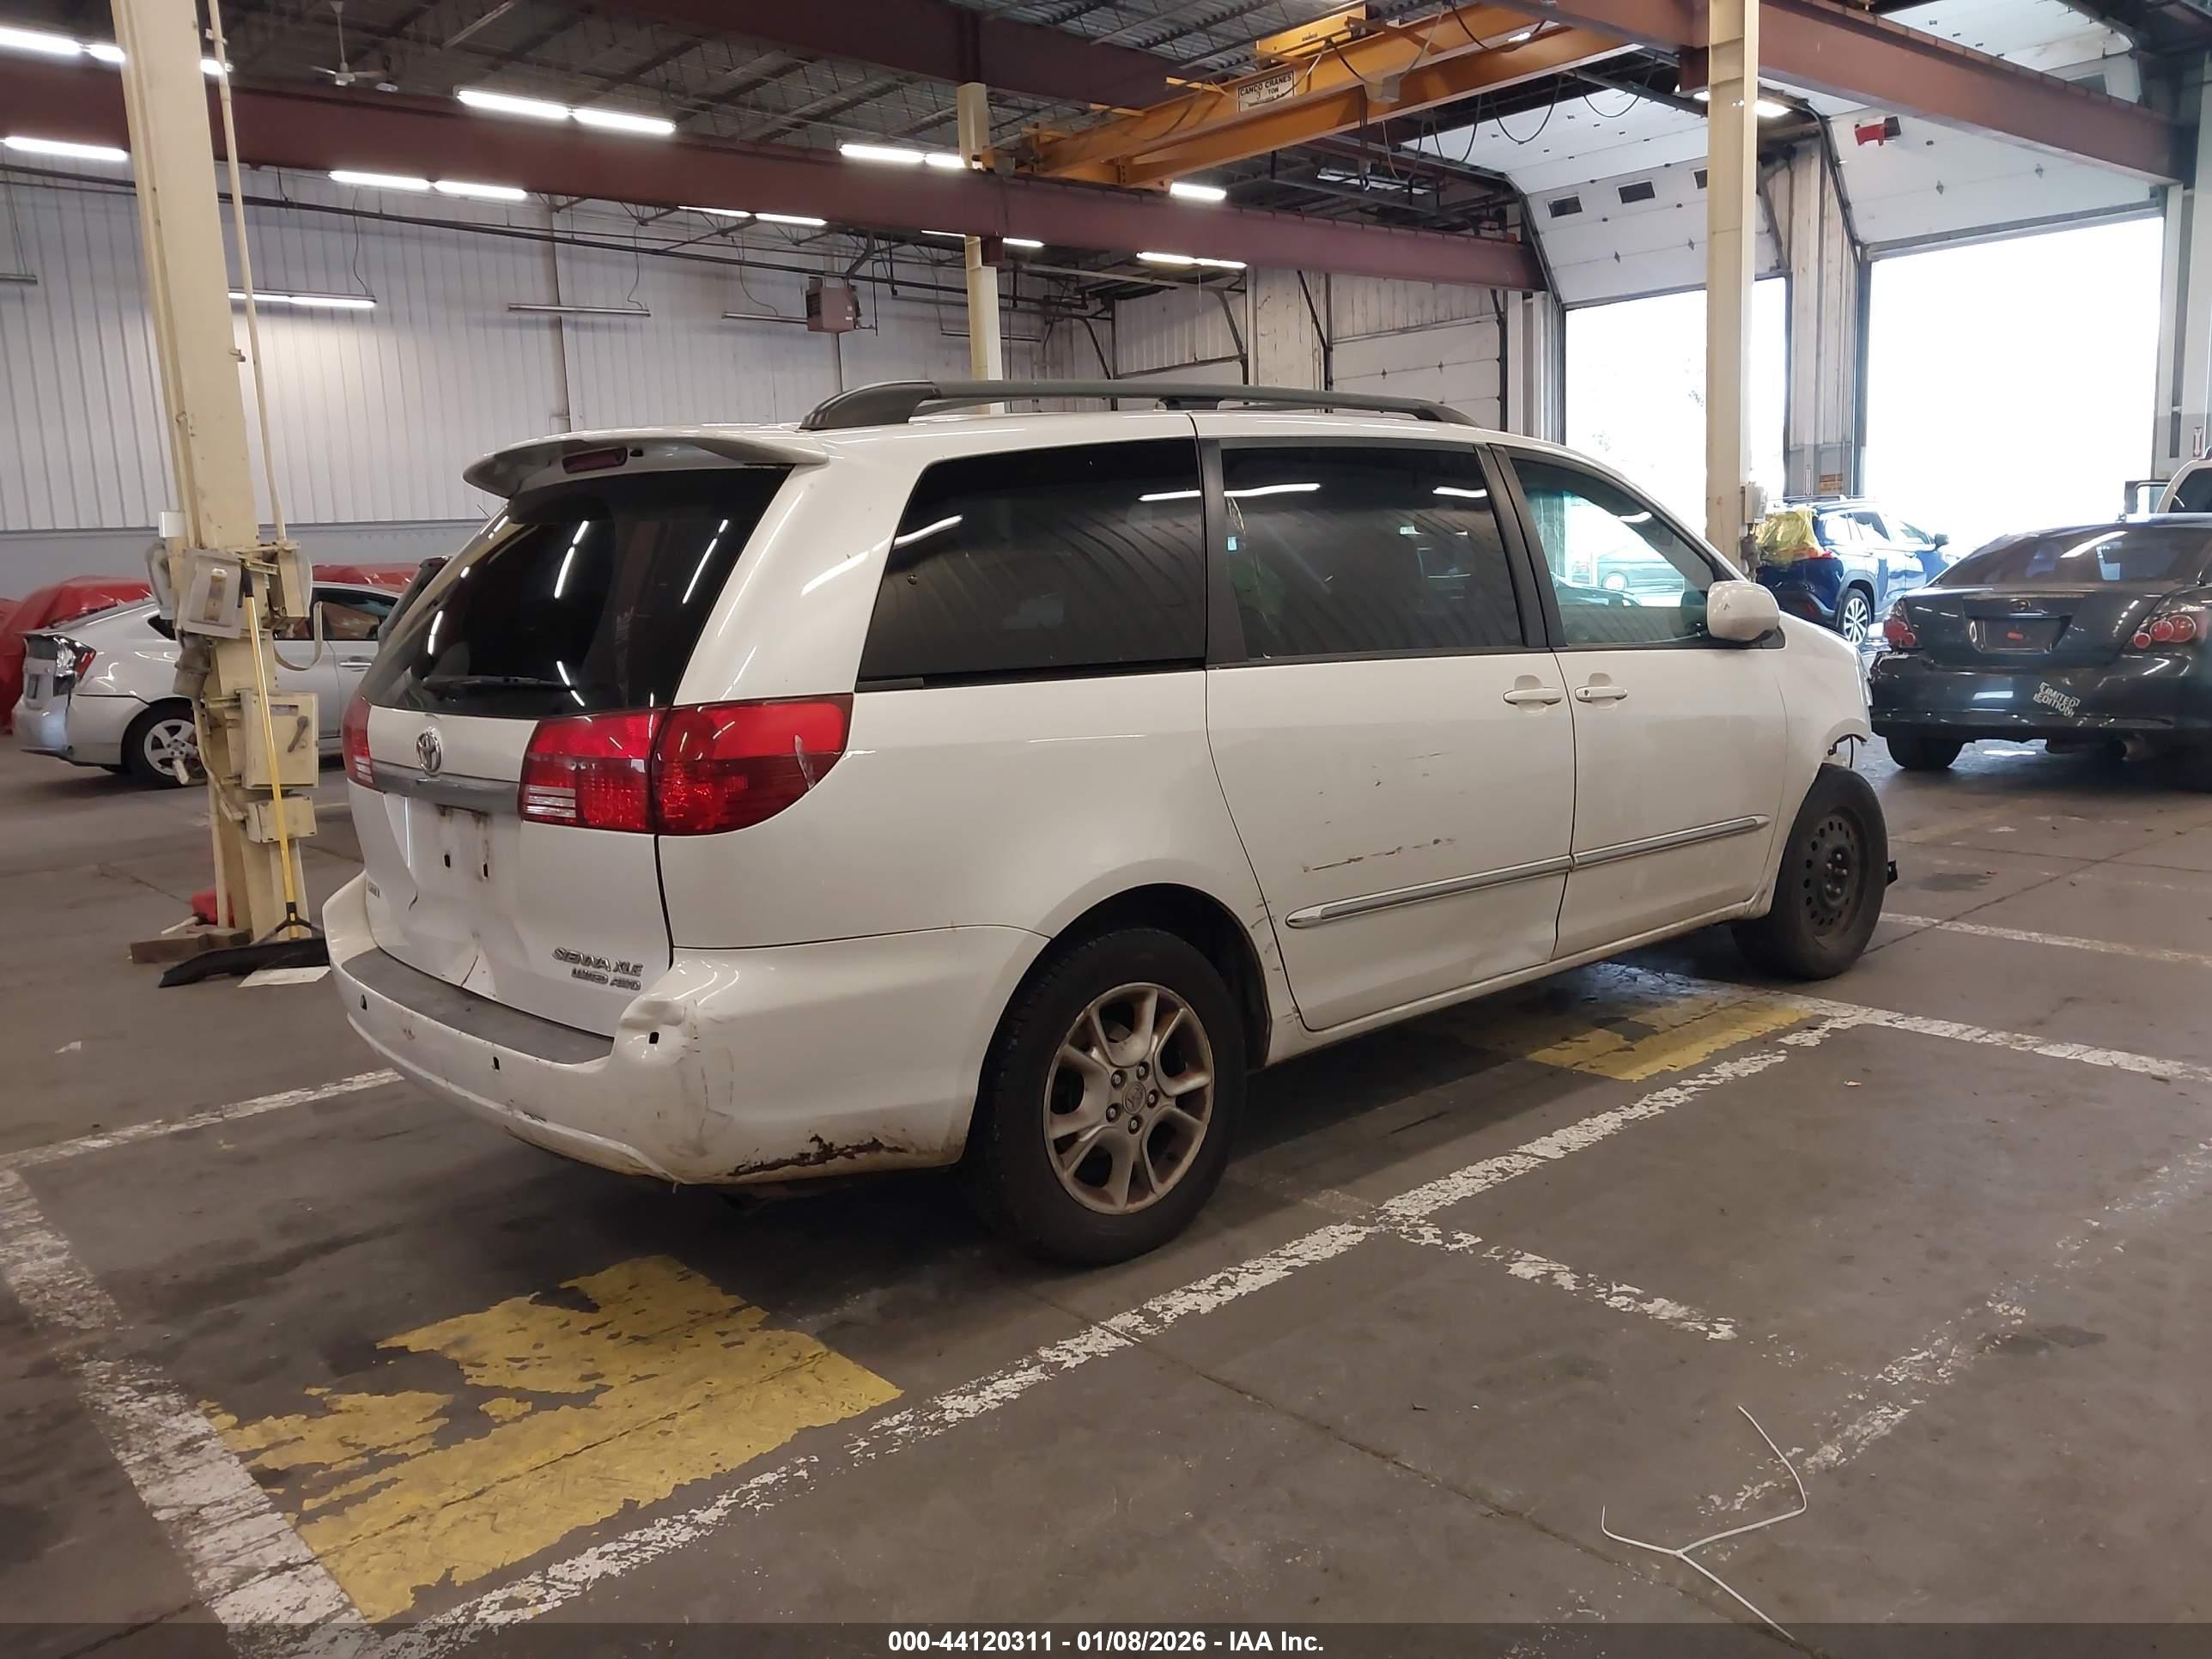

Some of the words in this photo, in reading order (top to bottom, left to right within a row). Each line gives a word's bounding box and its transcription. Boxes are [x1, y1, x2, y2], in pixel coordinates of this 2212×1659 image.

[1240, 83, 1263, 96] CANCO
[2036, 692, 2074, 716] EDITION
[2040, 685, 2077, 708] LIMITED
[613, 960, 643, 977] XLE
